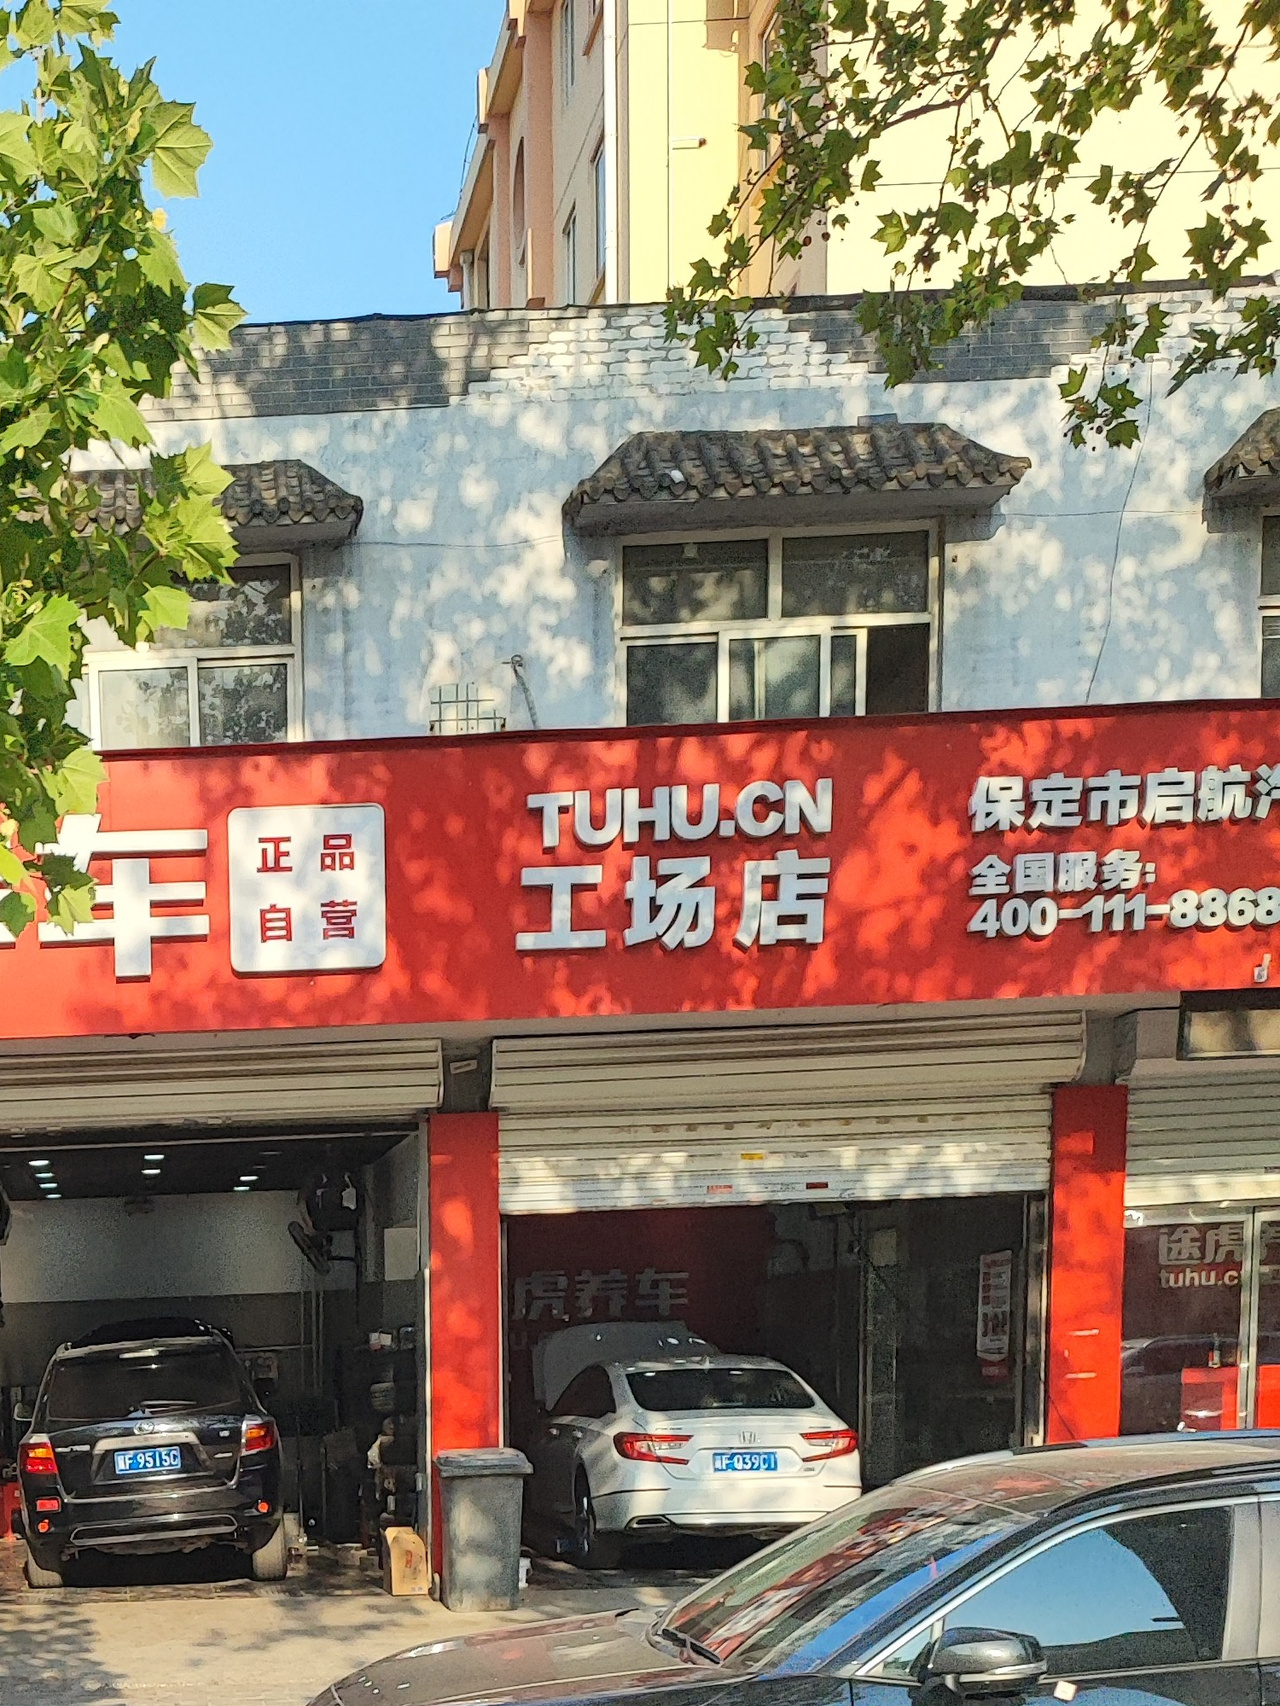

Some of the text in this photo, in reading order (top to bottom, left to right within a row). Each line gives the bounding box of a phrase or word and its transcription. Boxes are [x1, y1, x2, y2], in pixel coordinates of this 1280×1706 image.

[527, 779, 833, 848] TUHU.CN
[256, 833, 356, 873] 正品
[259, 900, 358, 943] 自营
[515, 849, 832, 951] 工场店
